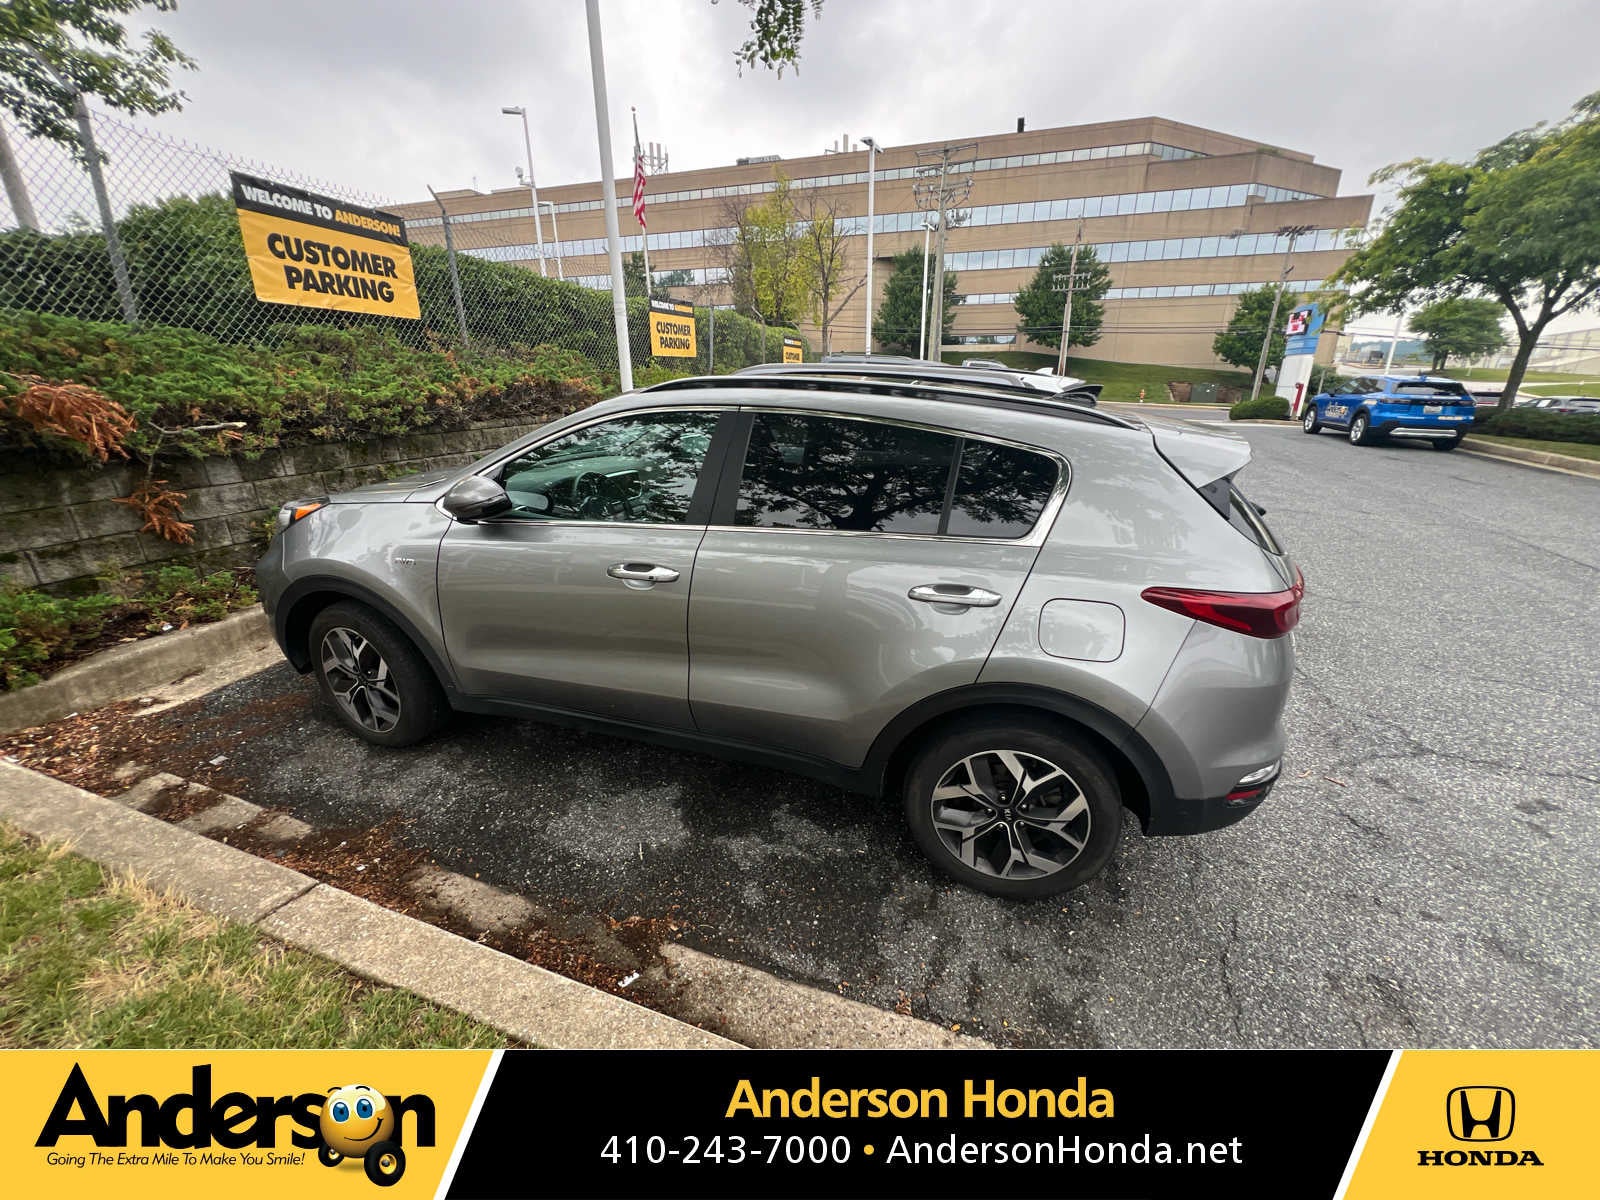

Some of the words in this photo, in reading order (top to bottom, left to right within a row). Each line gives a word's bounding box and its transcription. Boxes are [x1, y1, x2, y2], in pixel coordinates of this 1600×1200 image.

[240, 184, 313, 214] WELCOME
[313, 203, 333, 220] TO
[335, 209, 400, 238] ANDERSON!
[267, 232, 398, 279] CUSTOMER
[283, 265, 395, 303] PARKING
[656, 321, 691, 336] CUSTOMER
[659, 336, 690, 350] PARKING
